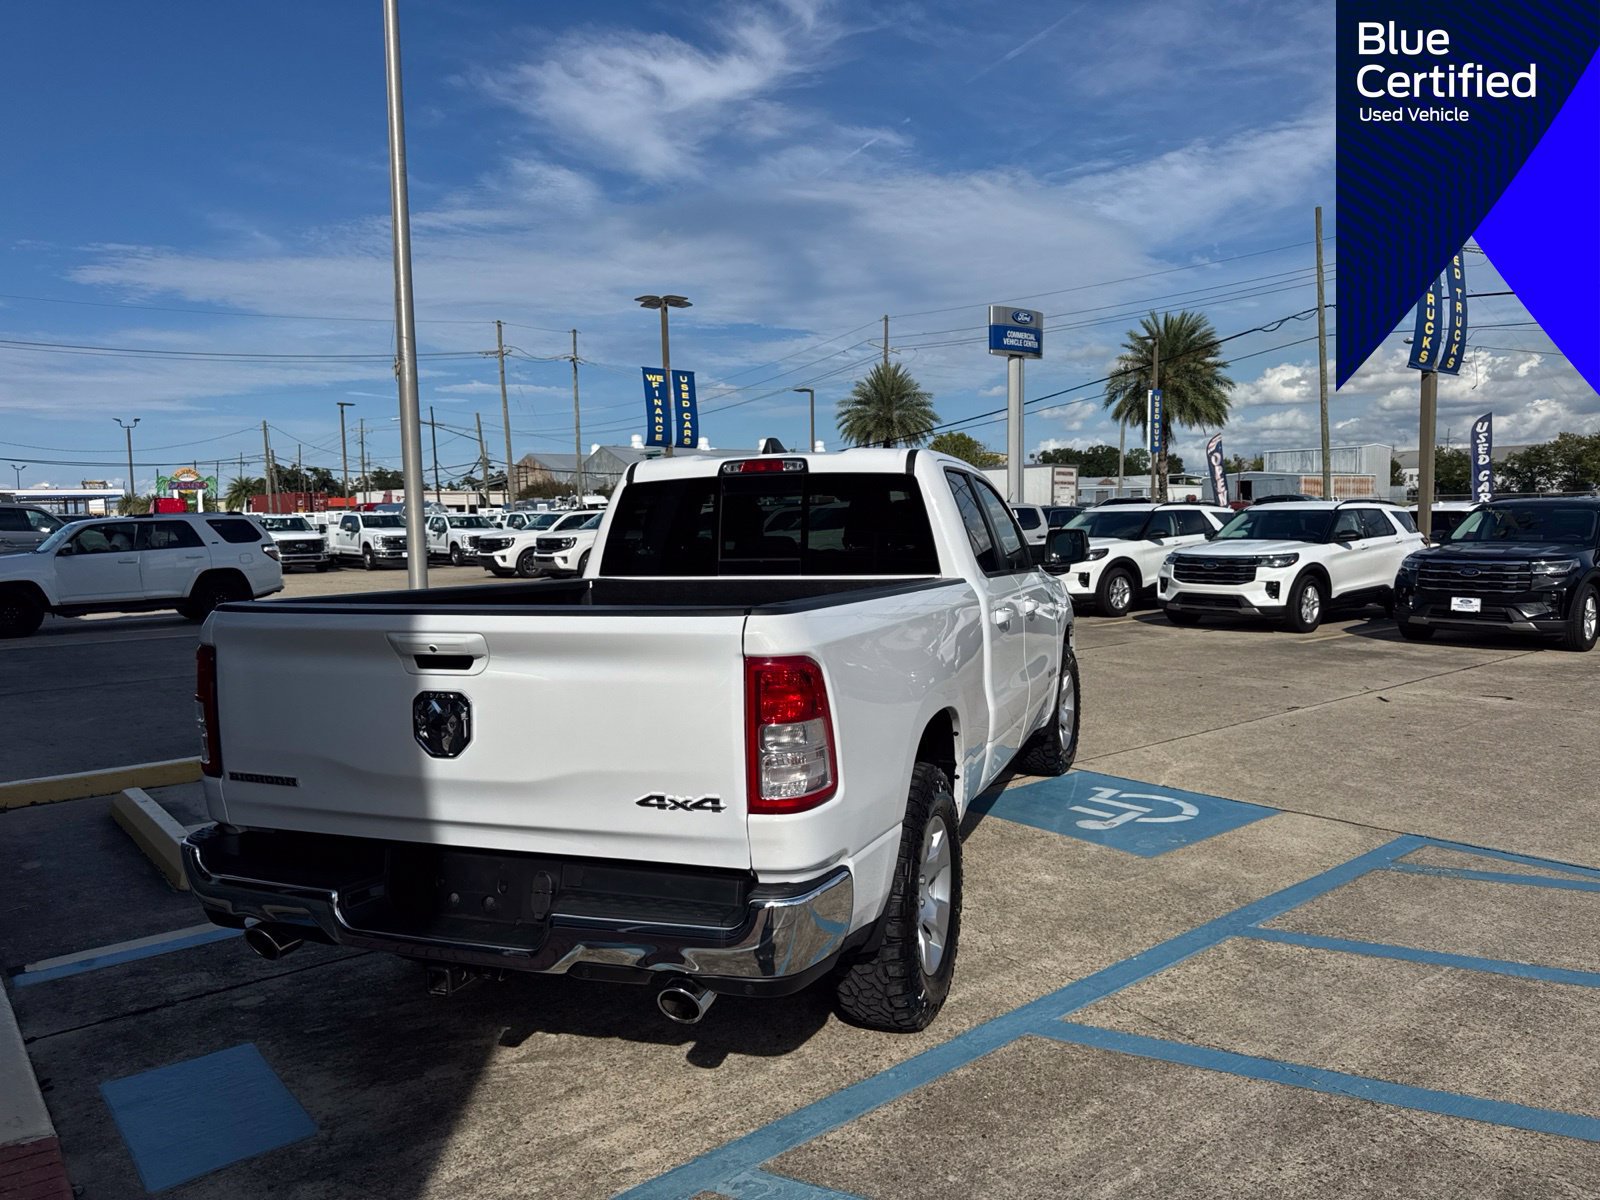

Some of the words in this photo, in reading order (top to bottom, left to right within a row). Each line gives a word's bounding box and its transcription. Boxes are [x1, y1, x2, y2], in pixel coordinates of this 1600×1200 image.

[1003, 338, 1022, 346] VEHICLE
[1023, 340, 1038, 348] CENTER
[1007, 330, 1035, 340] COMMERCIAL
[1446, 288, 1462, 369] TRUCKS
[646, 374, 664, 382] WE
[680, 376, 690, 407] USED
[652, 381, 663, 441] FINANCE
[683, 413, 691, 445] CARS
[1476, 421, 1490, 466] USED
[1211, 452, 1228, 507] OPEN
[1477, 469, 1492, 503] CAR
